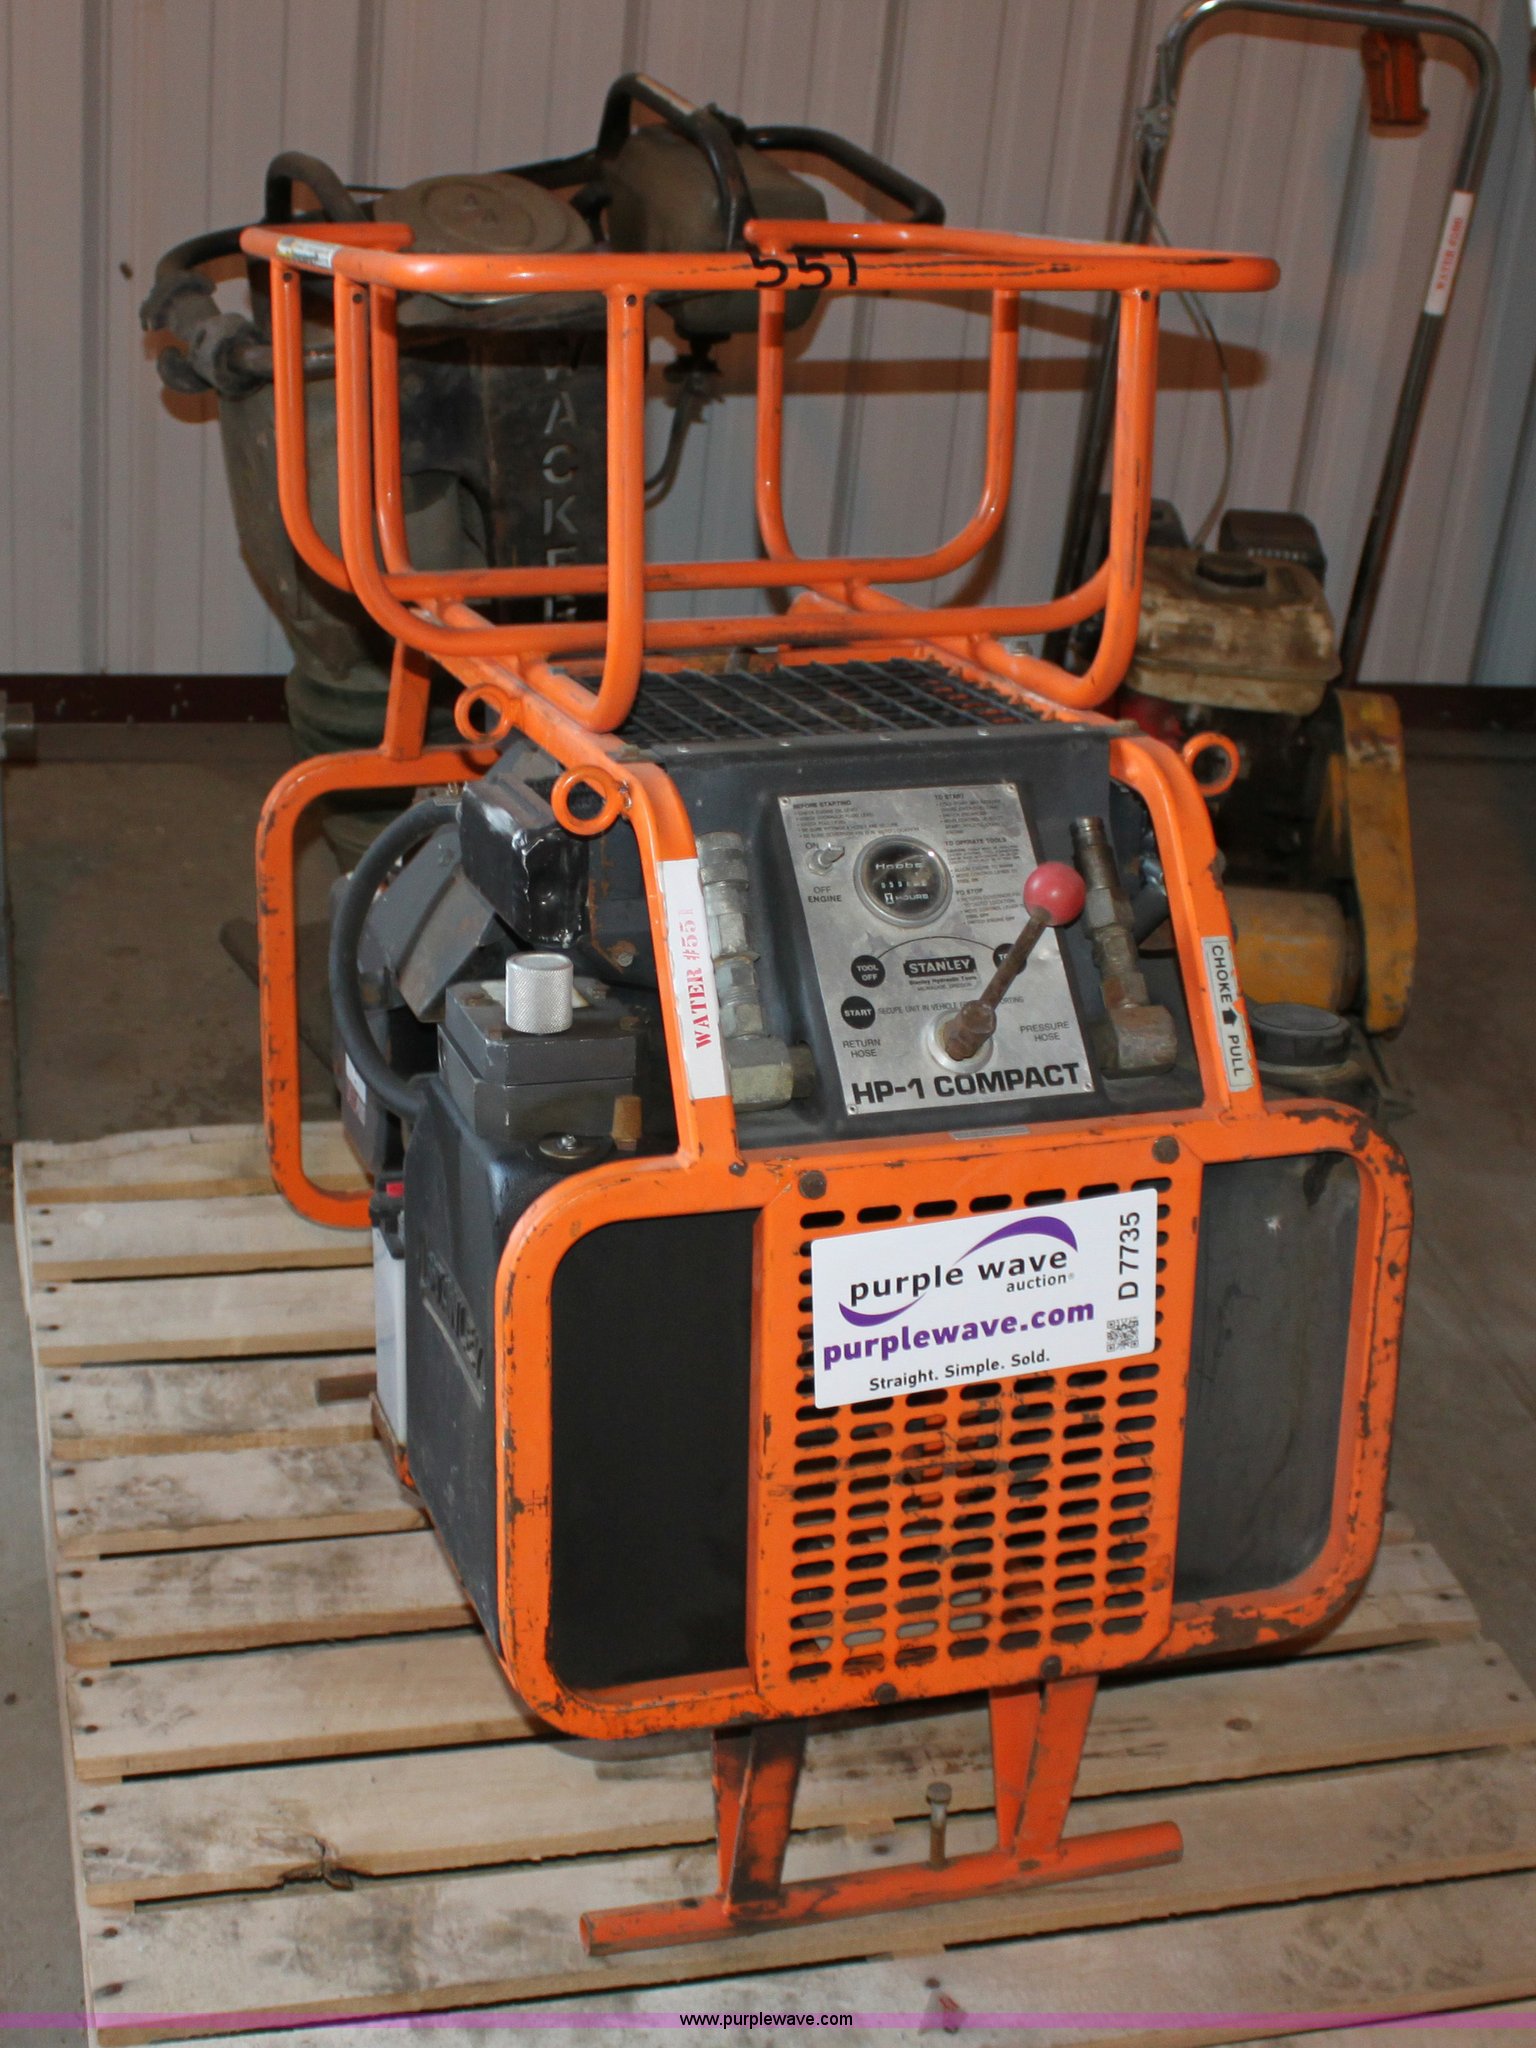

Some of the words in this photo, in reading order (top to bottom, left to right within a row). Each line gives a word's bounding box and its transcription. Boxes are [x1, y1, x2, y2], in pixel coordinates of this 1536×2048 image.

[748, 248, 858, 290] 551
[805, 842, 820, 850] ON
[813, 886, 832, 894] OFF
[808, 895, 843, 903] ENGINE
[856, 964, 880, 972] TOOL
[908, 960, 971, 974] STANLEY
[861, 974, 878, 982] OFF
[687, 967, 713, 1048] WATER
[844, 1009, 873, 1018] START
[1212, 944, 1233, 1003] CHOKE
[1228, 1034, 1245, 1077] PULL
[1020, 1021, 1070, 1034] PRESSURE
[843, 1038, 881, 1048] RETURN
[1033, 1032, 1061, 1042] HOSE
[851, 1049, 878, 1058] HOSE
[852, 1078, 926, 1105] HP-1
[934, 1063, 1080, 1098] COMPACT
[1118, 1211, 1141, 1277] 7735
[850, 1264, 965, 1307] purple
[977, 1250, 1069, 1281] wave
[1118, 1281, 1140, 1301] D
[822, 1302, 1095, 1371] purplewave.com
[868, 1369, 939, 1392] Straight.
[944, 1358, 1005, 1380] Simple.
[1010, 1349, 1051, 1367] Sold.
